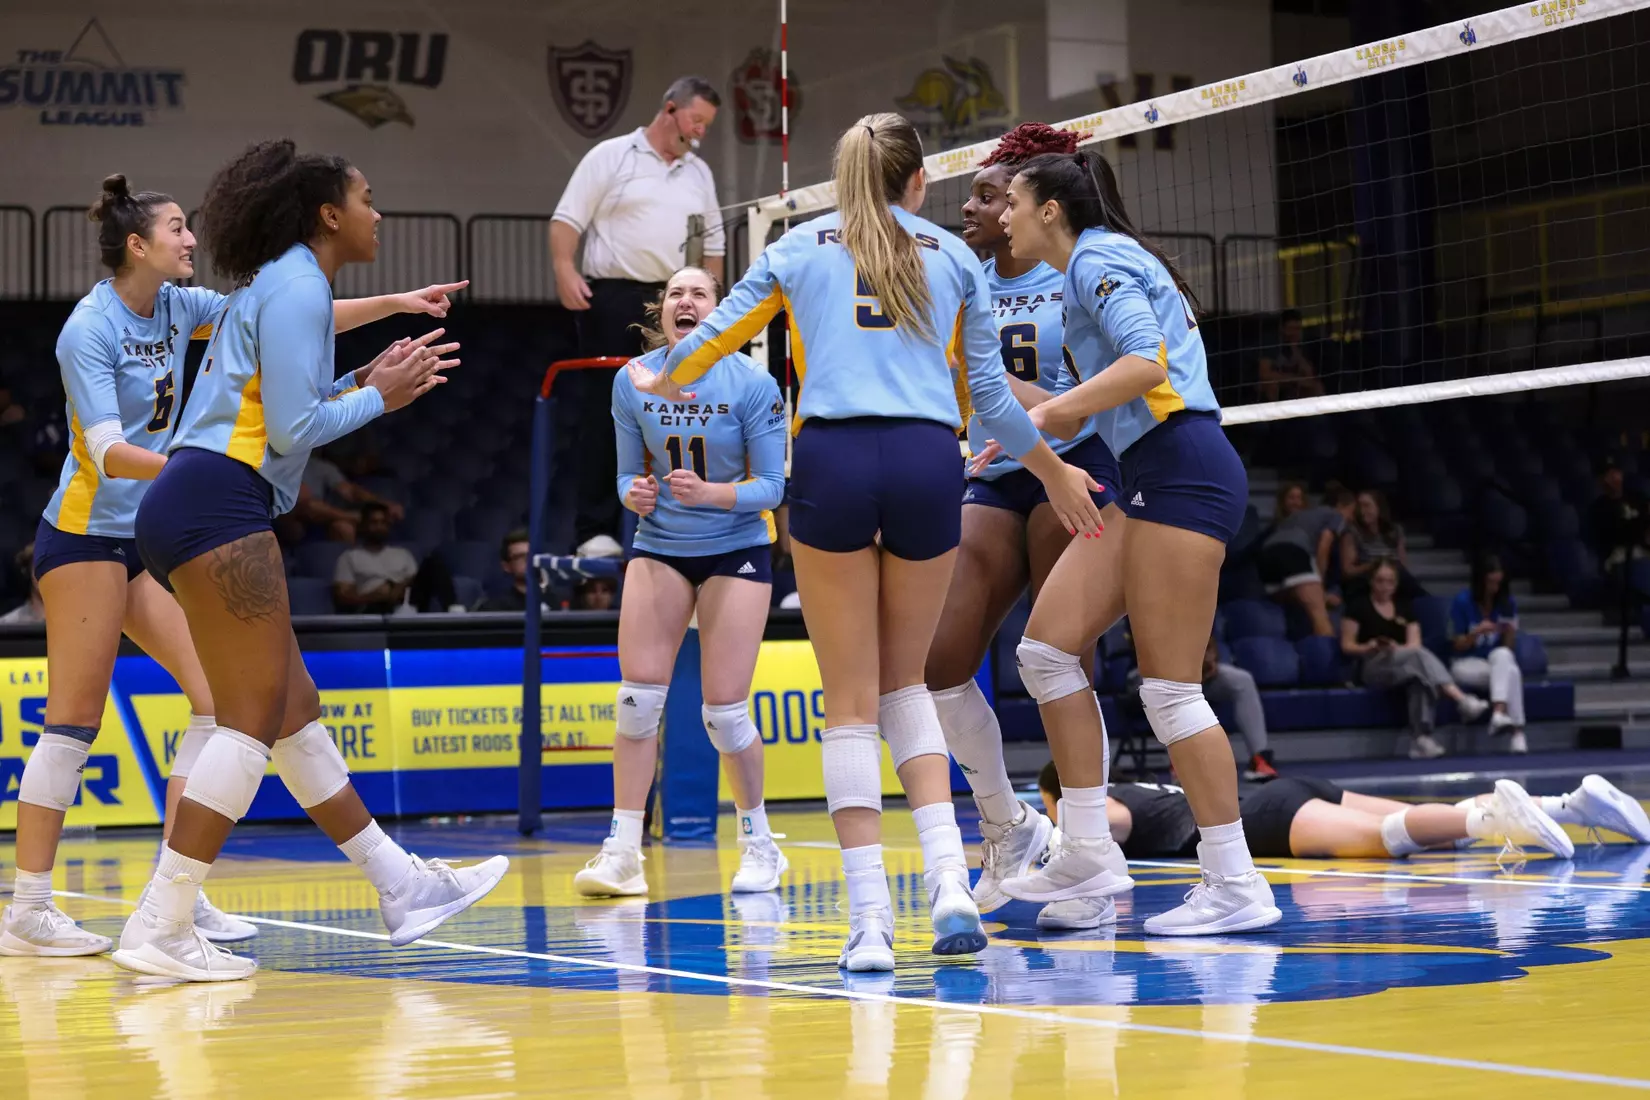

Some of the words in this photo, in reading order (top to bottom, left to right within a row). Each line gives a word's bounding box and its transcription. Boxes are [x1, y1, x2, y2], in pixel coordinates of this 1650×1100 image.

[1544, 8, 1575, 26] CITY
[17, 50, 63, 63] THE
[1356, 39, 1405, 60] KANSAS
[293, 30, 449, 89] ORU
[1368, 53, 1396, 69] CITY
[0, 69, 184, 107] SUMMIT
[40, 110, 144, 126] LEAGUE
[992, 292, 1063, 309] NSAS
[644, 402, 729, 415] KANSAS
[660, 415, 710, 427] CITY
[768, 414, 785, 426] ROO
[665, 435, 708, 482] 11
[9, 672, 44, 684] LAT
[320, 704, 346, 717] OW
[354, 703, 373, 717] AT
[412, 709, 441, 728] BUY
[447, 707, 508, 725] TICKETS
[560, 704, 585, 723] ALL
[590, 704, 616, 722] THE
[414, 735, 467, 755] LATEST
[472, 733, 512, 752] ROOS
